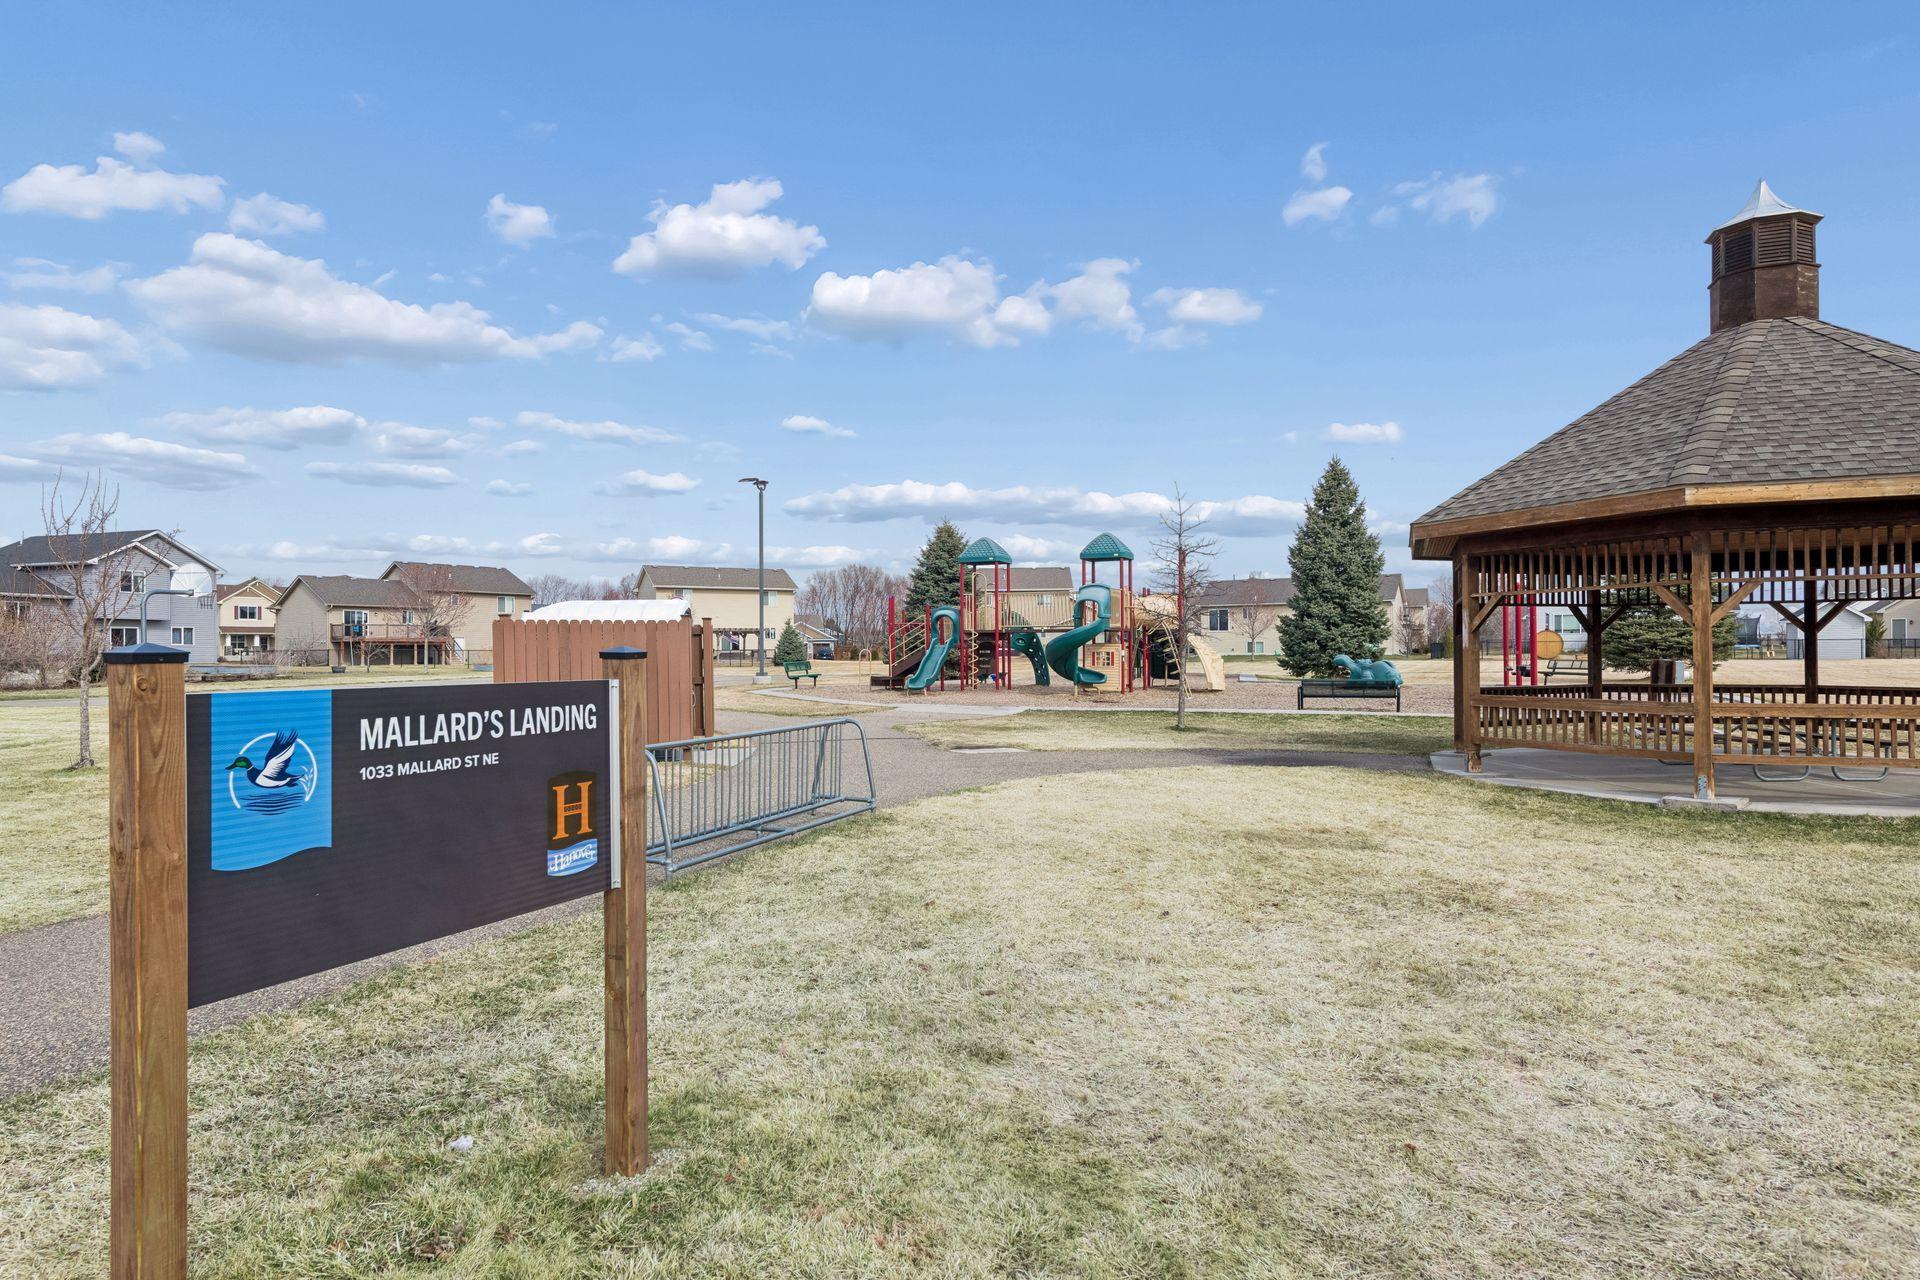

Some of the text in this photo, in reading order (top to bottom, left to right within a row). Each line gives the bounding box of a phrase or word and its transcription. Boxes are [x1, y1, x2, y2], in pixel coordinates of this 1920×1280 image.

[360, 703, 597, 751] MALLARD'S LANDING
[360, 752, 499, 780] 1033 MALLARD ST NE
[552, 781, 593, 840] H
[549, 843, 596, 872] Hanover
